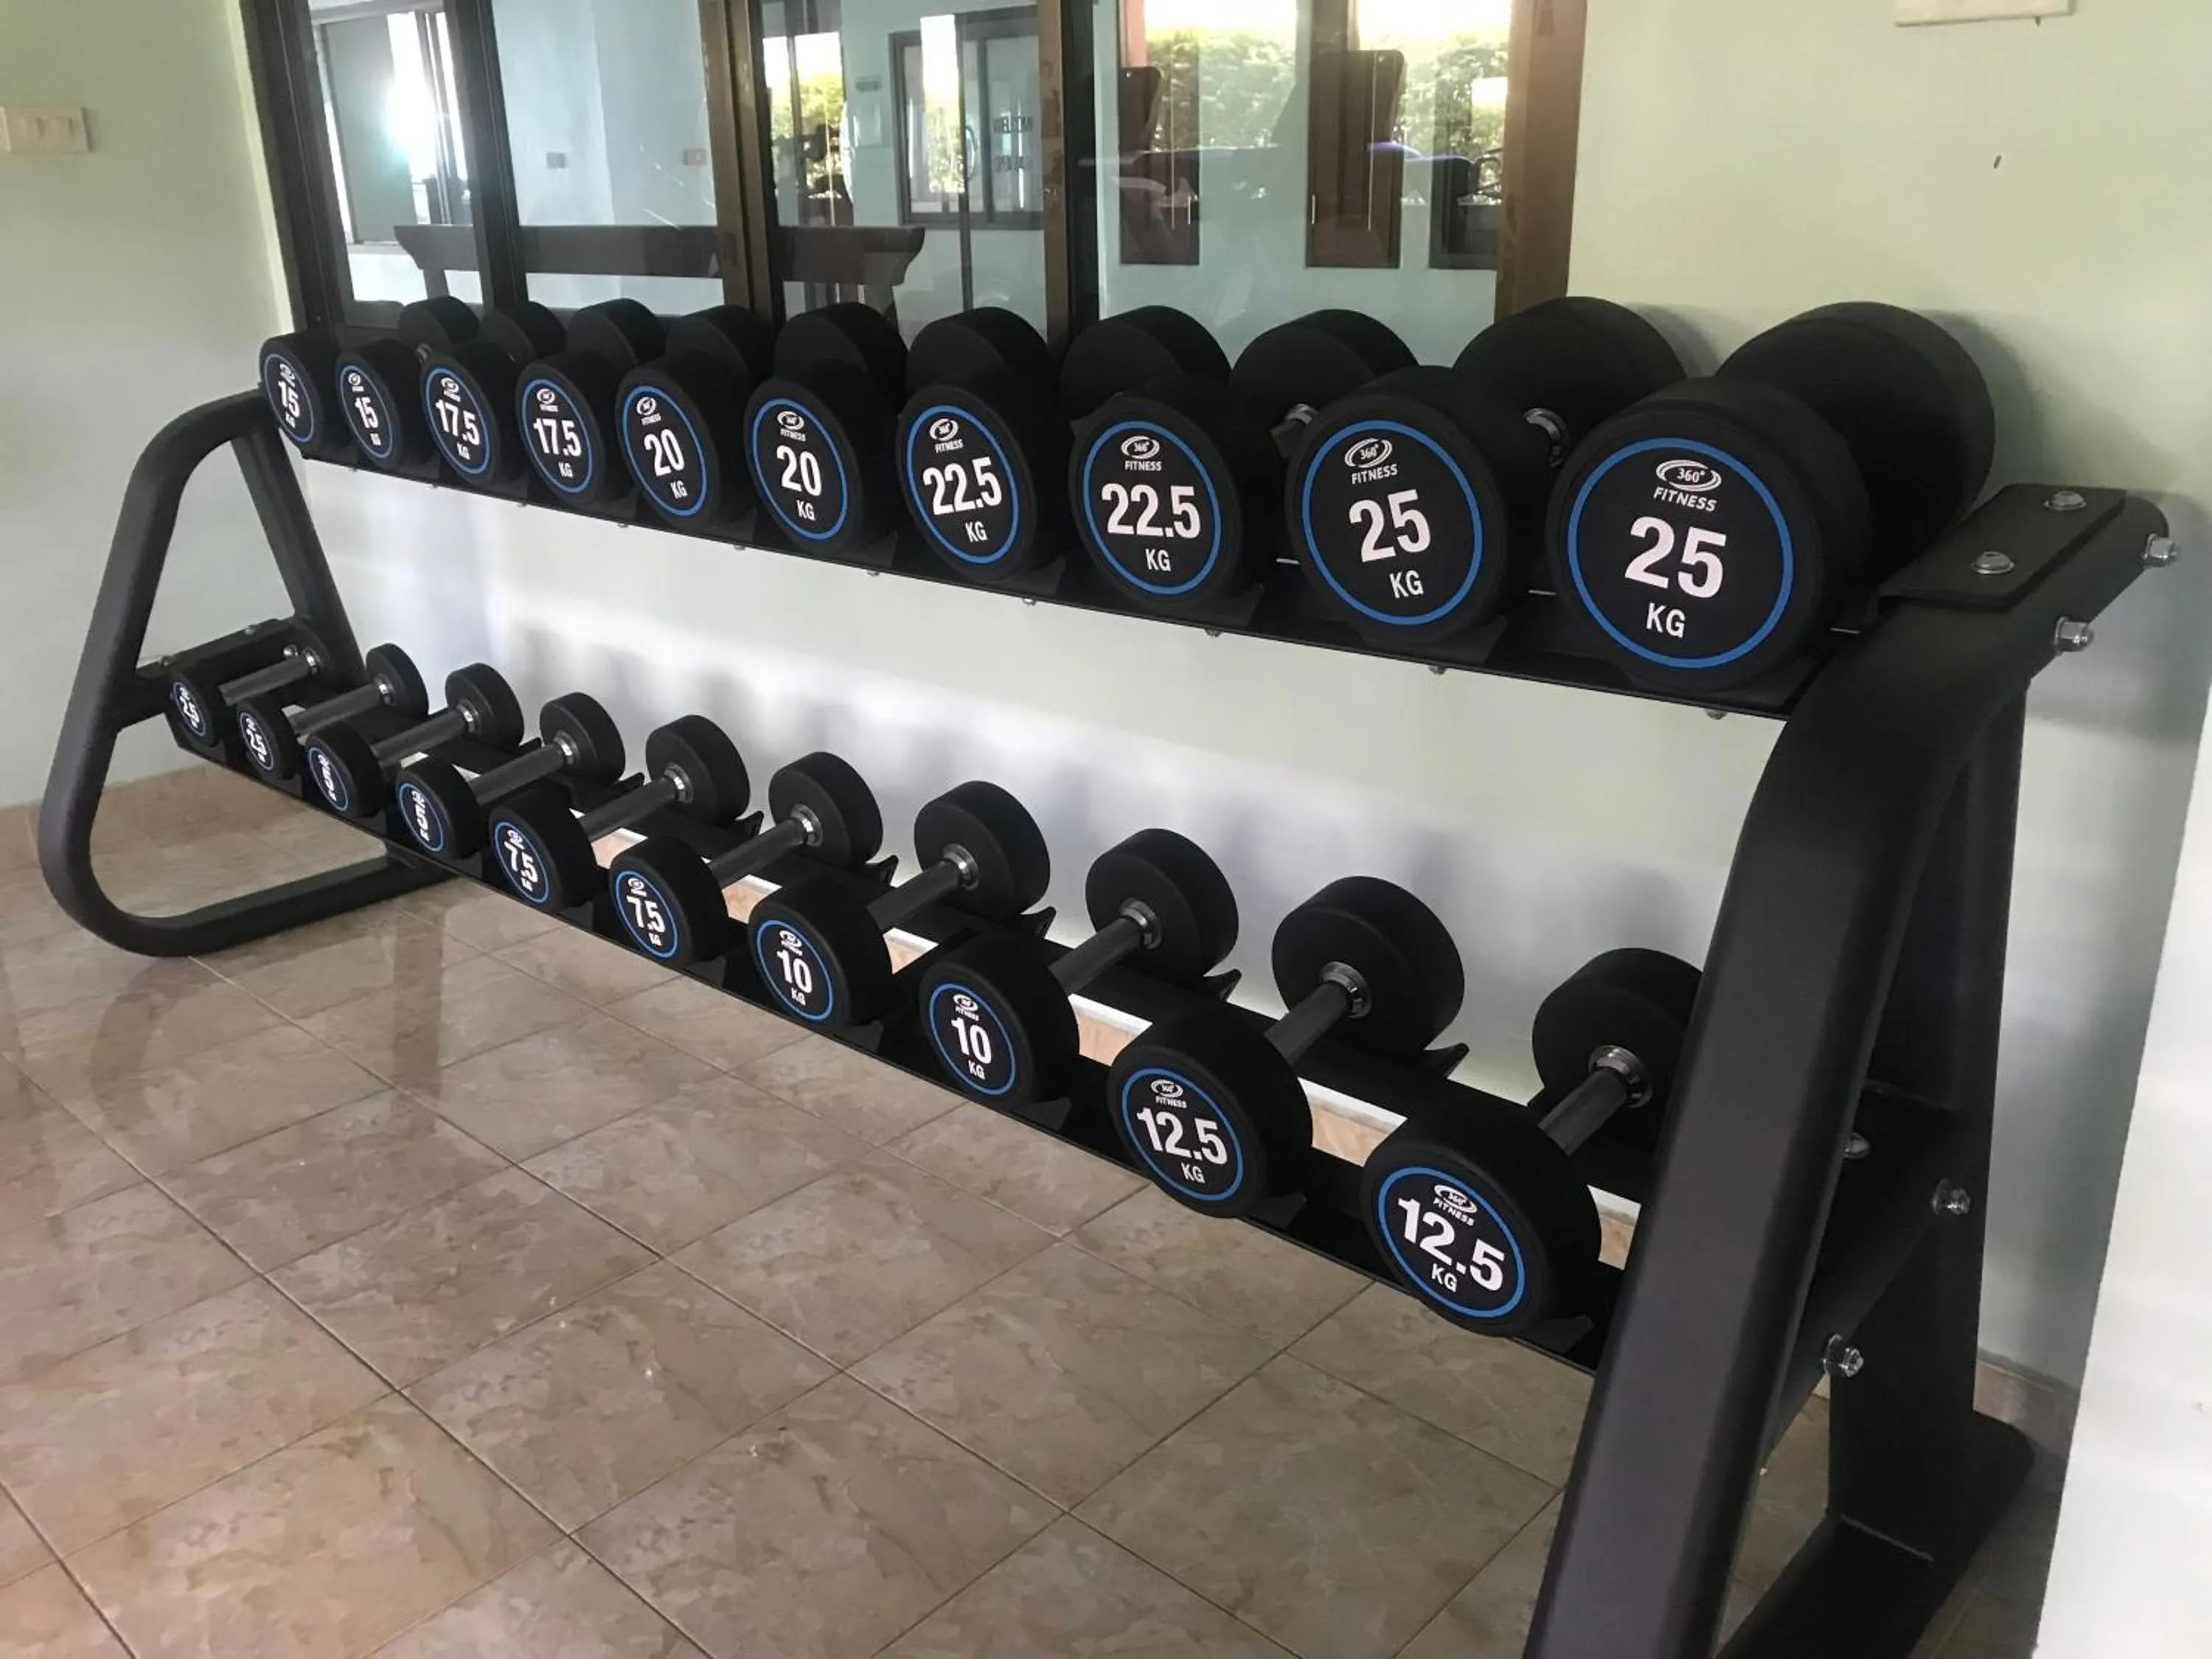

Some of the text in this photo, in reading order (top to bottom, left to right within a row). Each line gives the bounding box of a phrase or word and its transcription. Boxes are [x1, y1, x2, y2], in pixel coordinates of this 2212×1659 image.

[279, 380, 300, 417] 15
[355, 397, 378, 428] 15
[435, 399, 480, 446] 17.5
[533, 418, 582, 457] 17.5
[644, 429, 685, 476] 20
[935, 439, 964, 453] FITNESS
[776, 445, 822, 496] 20
[1124, 461, 1162, 471] FITNESS
[1351, 464, 1398, 484] FITNESS
[670, 481, 688, 499] KG
[922, 456, 1002, 515] 22.5
[1652, 487, 1717, 512] FITNESS
[796, 499, 815, 521] KG
[1101, 483, 1201, 539] 22.5
[1349, 489, 1431, 563] 25
[965, 521, 988, 543] KG
[1145, 549, 1172, 571] KG
[1624, 516, 1727, 598] 25
[1389, 569, 1424, 599] KG
[1646, 602, 1686, 638] KG
[504, 841, 538, 883] 7.5
[626, 894, 666, 933] 7.5
[776, 949, 813, 993] 10
[950, 1017, 992, 1064] 10
[968, 1060, 985, 1080] KG
[1155, 1096, 1188, 1108] FITNESS
[1136, 1107, 1228, 1164] 12.5
[1180, 1163, 1206, 1183] KG
[1433, 1197, 1475, 1226] FITNESS
[1397, 1197, 1505, 1291] 12.5
[1431, 1263, 1458, 1293] KG
